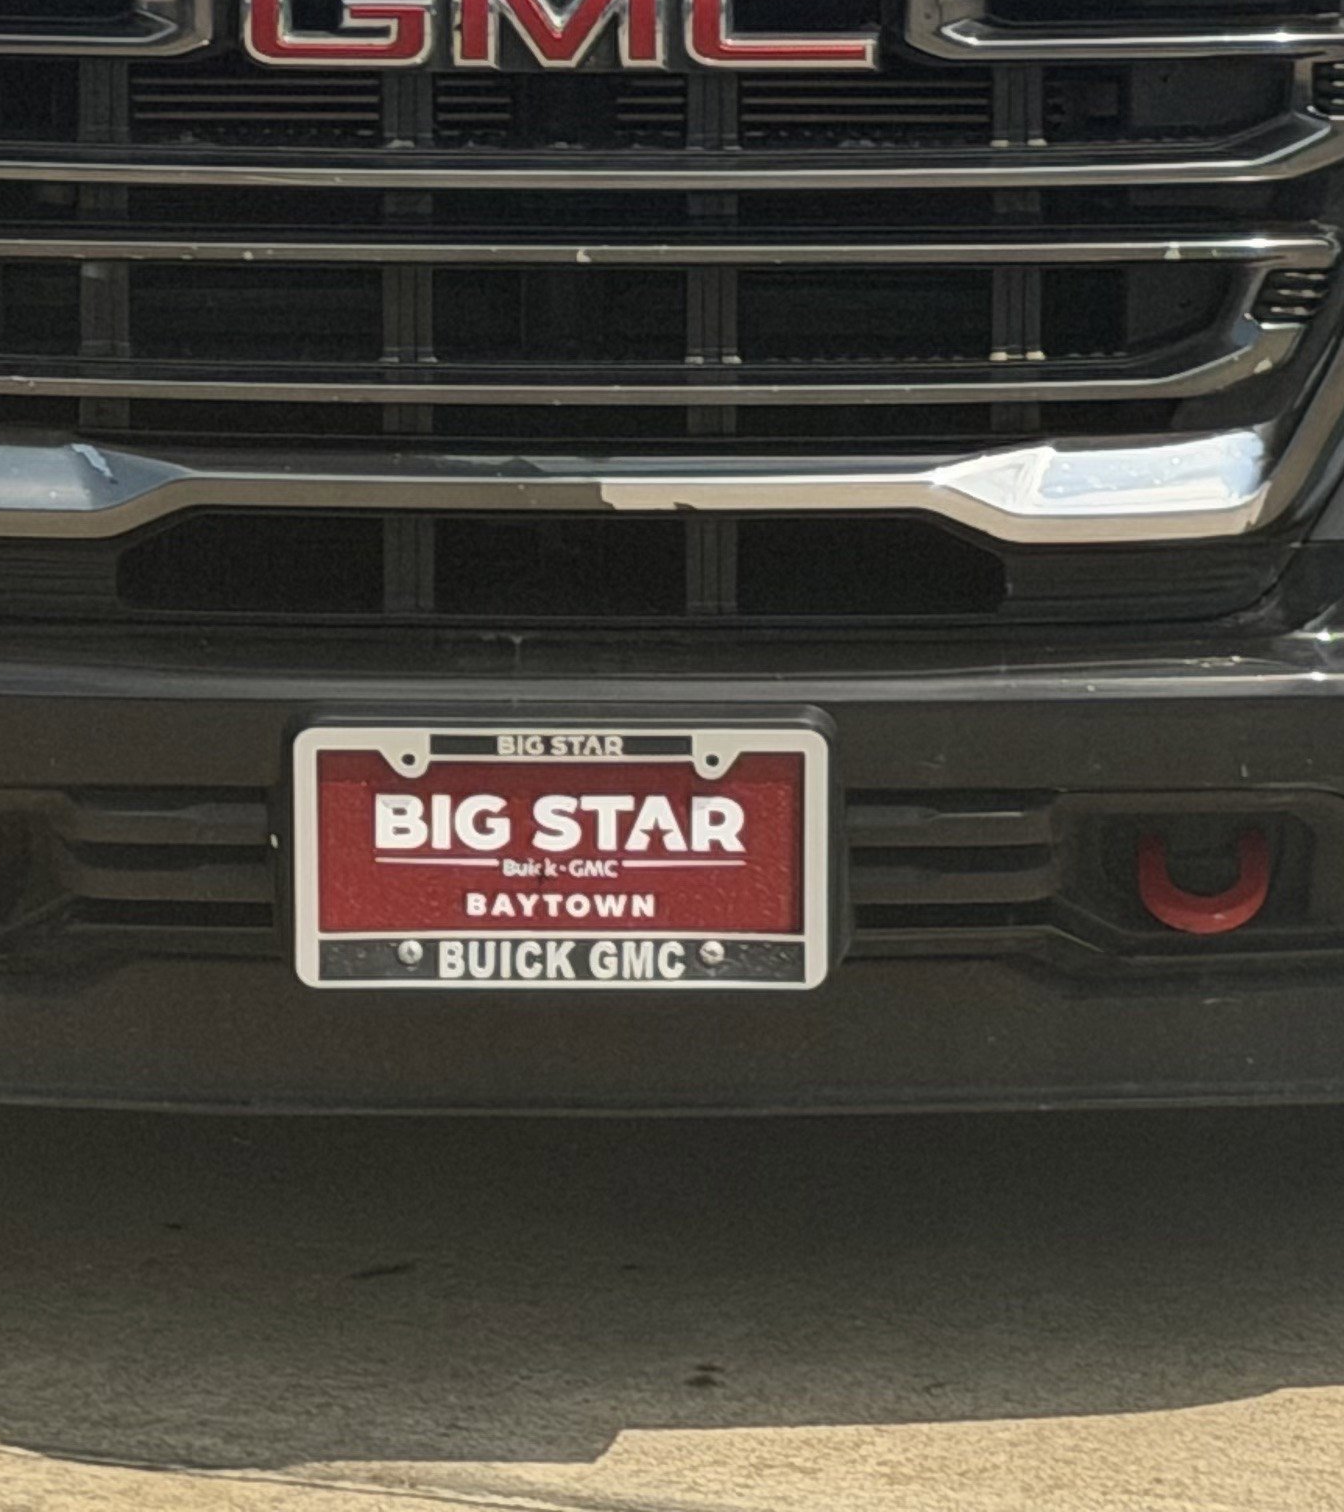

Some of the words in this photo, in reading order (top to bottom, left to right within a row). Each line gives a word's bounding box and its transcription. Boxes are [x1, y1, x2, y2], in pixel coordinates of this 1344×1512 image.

[496, 734, 545, 757] BIG
[550, 734, 625, 757] STAR
[374, 793, 513, 851] BIG
[531, 793, 747, 853] STAR
[465, 891, 655, 918] BAYTOWN
[437, 939, 577, 980] BUICK
[588, 939, 688, 981] GMC
